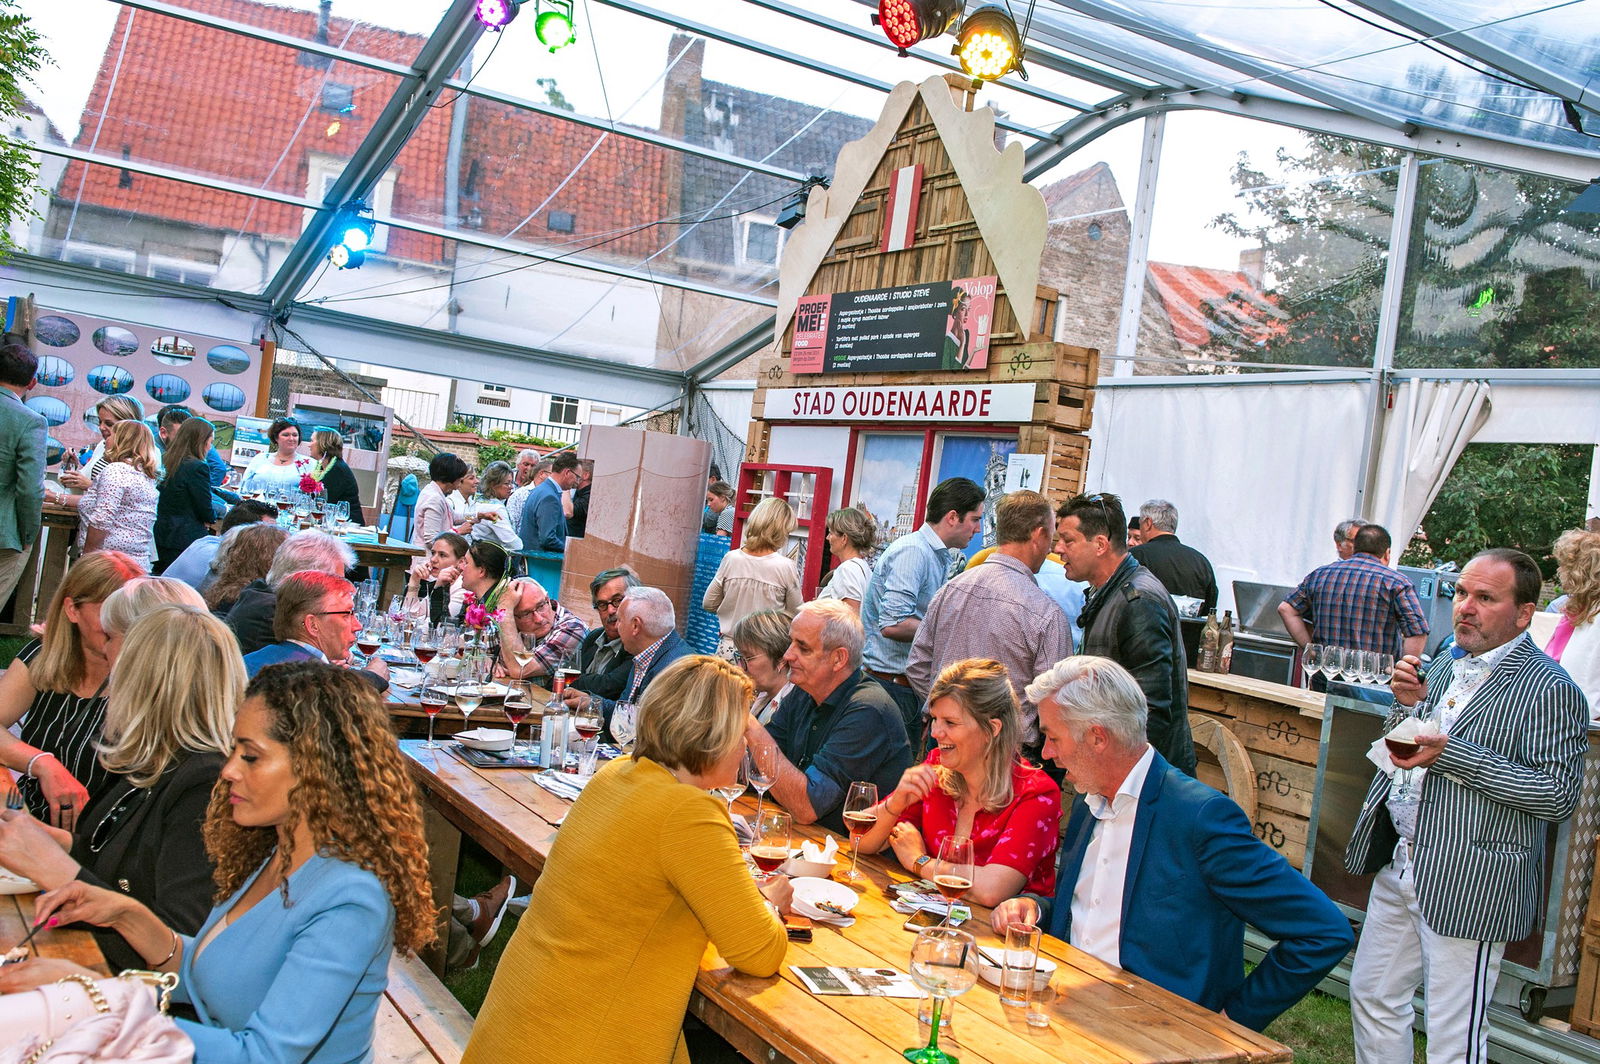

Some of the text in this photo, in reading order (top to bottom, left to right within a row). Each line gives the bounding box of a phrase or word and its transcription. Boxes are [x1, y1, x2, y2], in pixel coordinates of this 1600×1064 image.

[854, 293, 888, 303] OUDENAARDE
[893, 290, 912, 300] STUDIO
[913, 288, 930, 298] STEVE
[964, 281, 993, 300] Volop
[799, 302, 828, 315] PROEF
[793, 390, 992, 417] STAD OUDENAARDE
